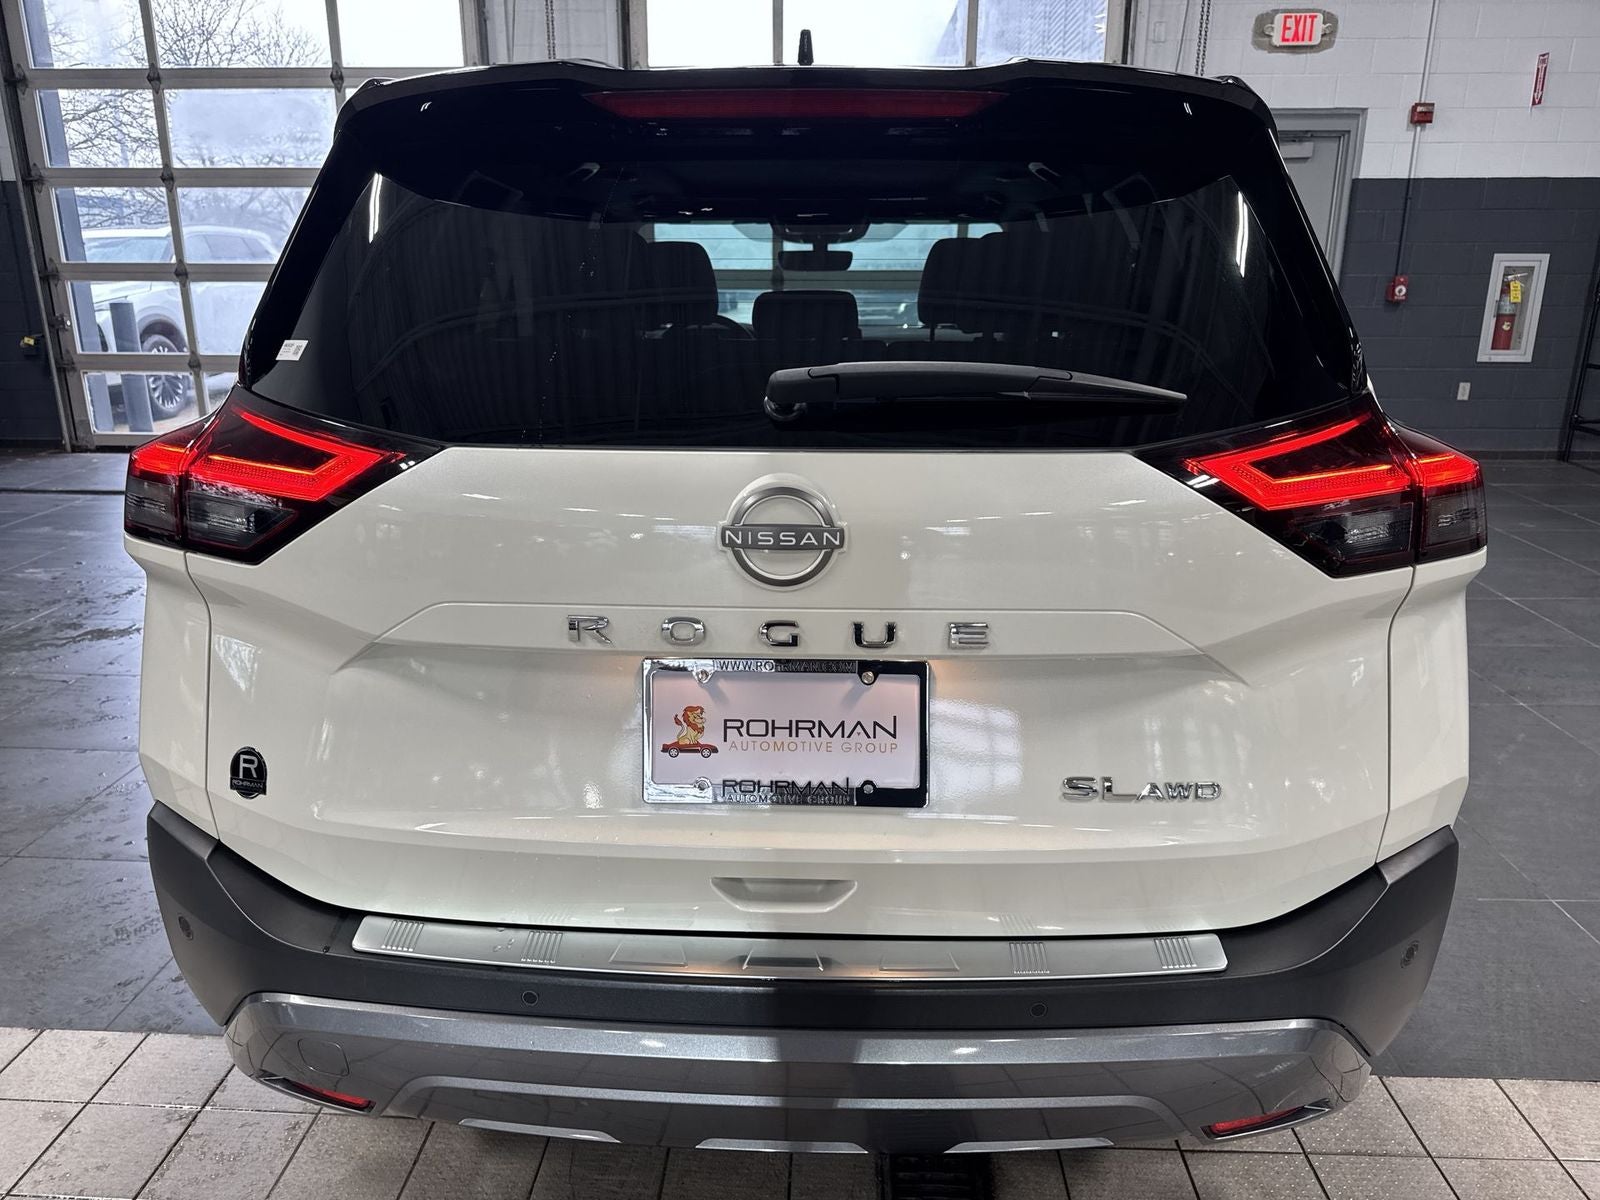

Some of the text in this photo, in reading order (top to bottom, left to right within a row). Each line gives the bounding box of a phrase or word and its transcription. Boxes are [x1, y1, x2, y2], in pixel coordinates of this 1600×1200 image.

[1281, 14, 1318, 43] EXIT
[725, 530, 840, 546] NISSAN
[567, 615, 989, 650] ROGUE
[723, 715, 897, 743] ROHRMAN
[728, 740, 898, 754] AUTOMOTIVE GROUP
[239, 754, 258, 779] R
[722, 777, 849, 797] ROHRMAN
[1062, 776, 1222, 801] SL AWD
